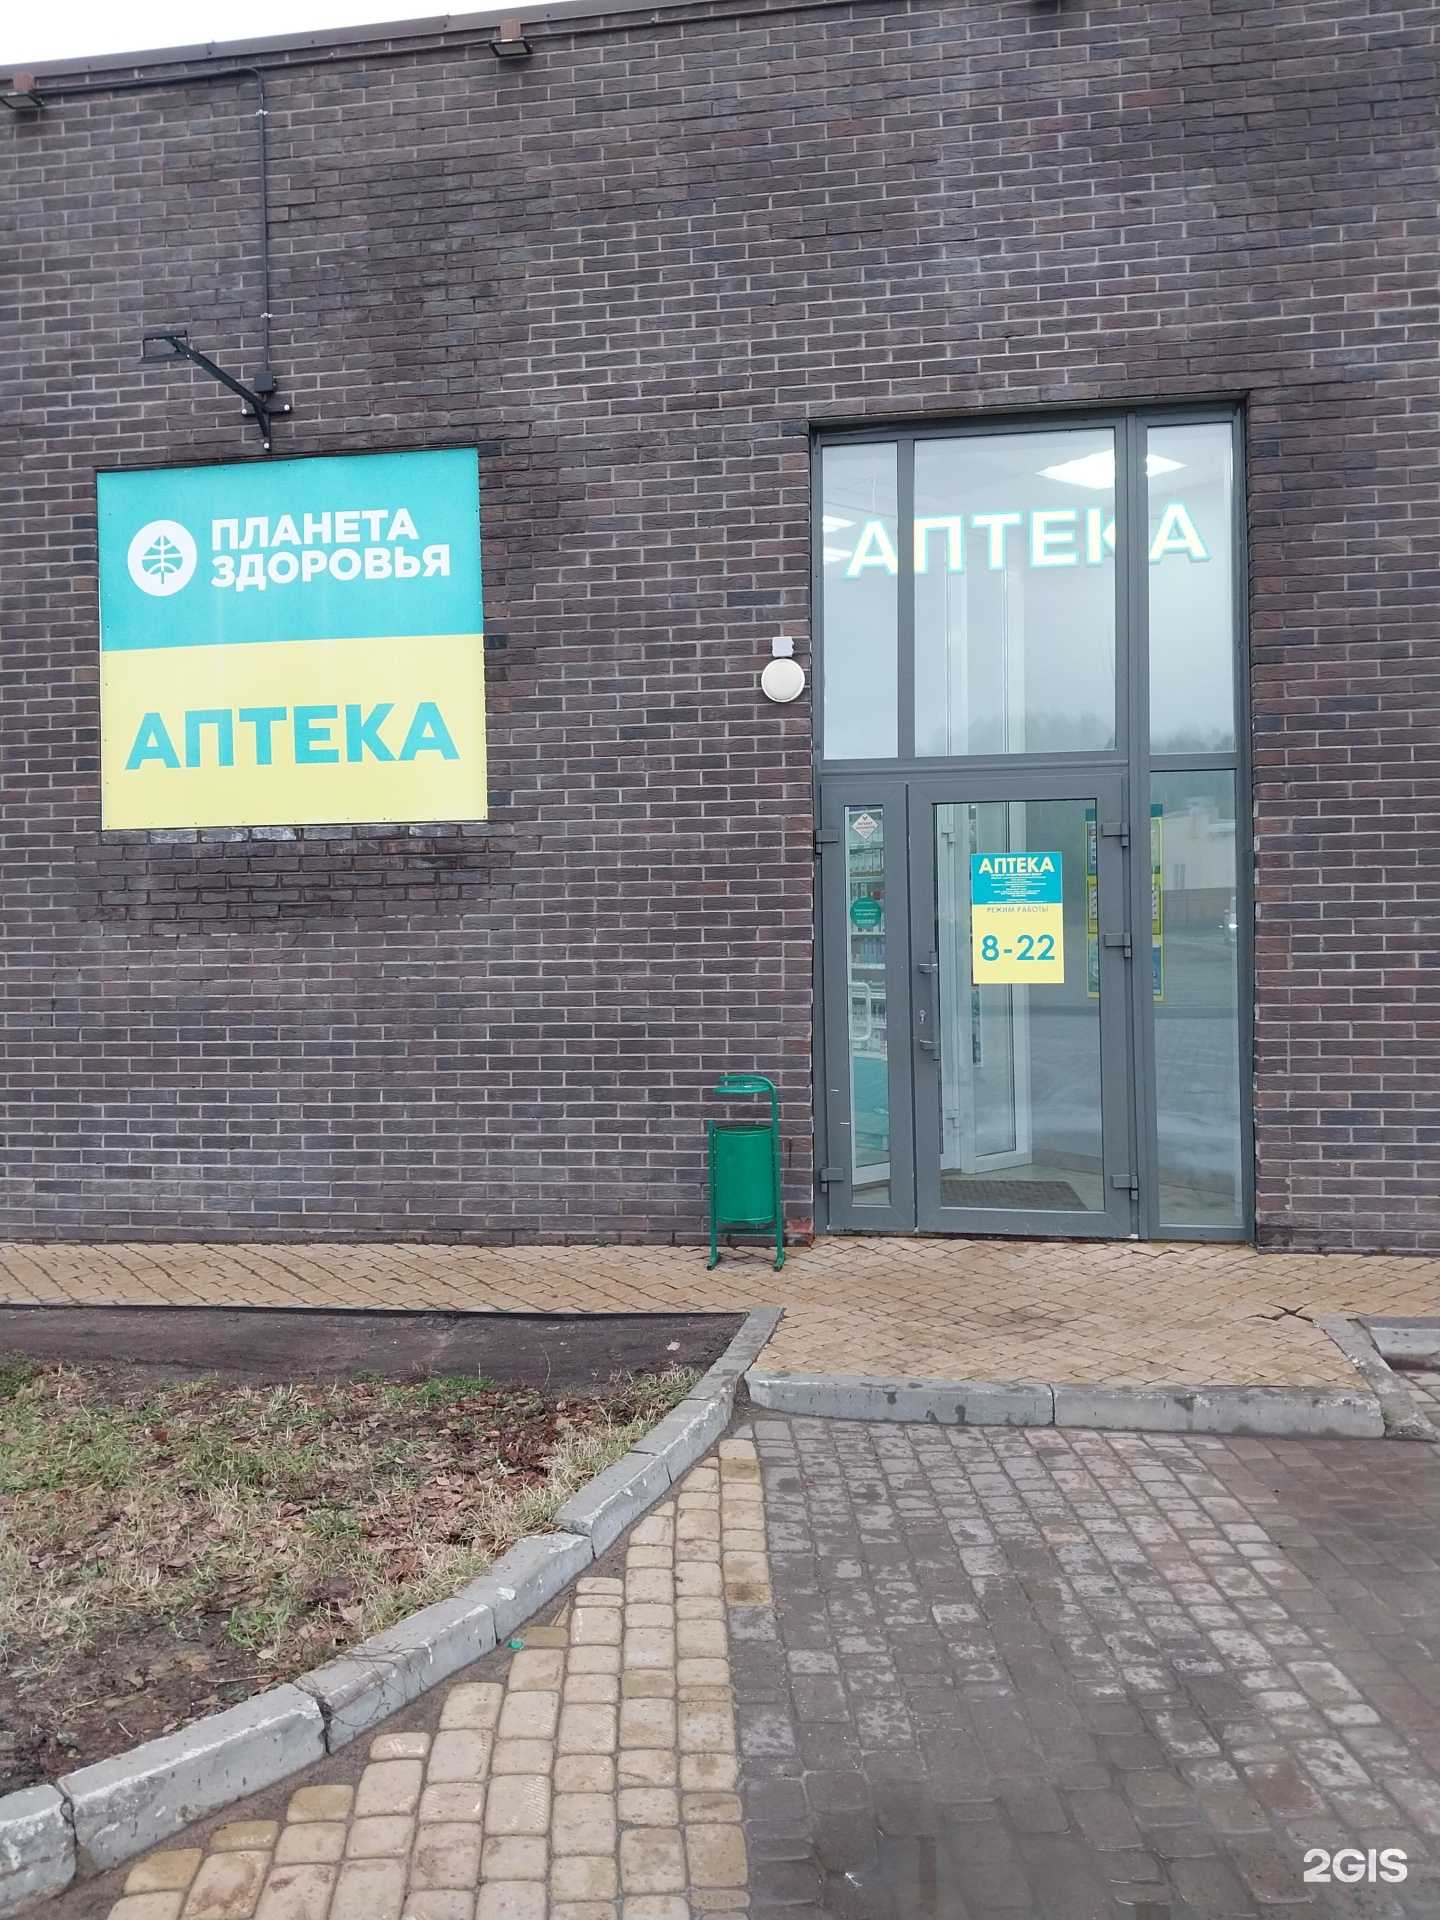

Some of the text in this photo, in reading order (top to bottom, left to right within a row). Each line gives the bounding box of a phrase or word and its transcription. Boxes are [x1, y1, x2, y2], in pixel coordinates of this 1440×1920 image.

[211, 508, 420, 551] ПЛАНЕТА
[843, 502, 1211, 578] АПТЕКА
[211, 543, 450, 592] ЗДОРОВЬЯ
[125, 702, 460, 770] АПТЕКА
[978, 856, 1056, 875] АПТЕКА
[981, 934, 1056, 962] 8-22
